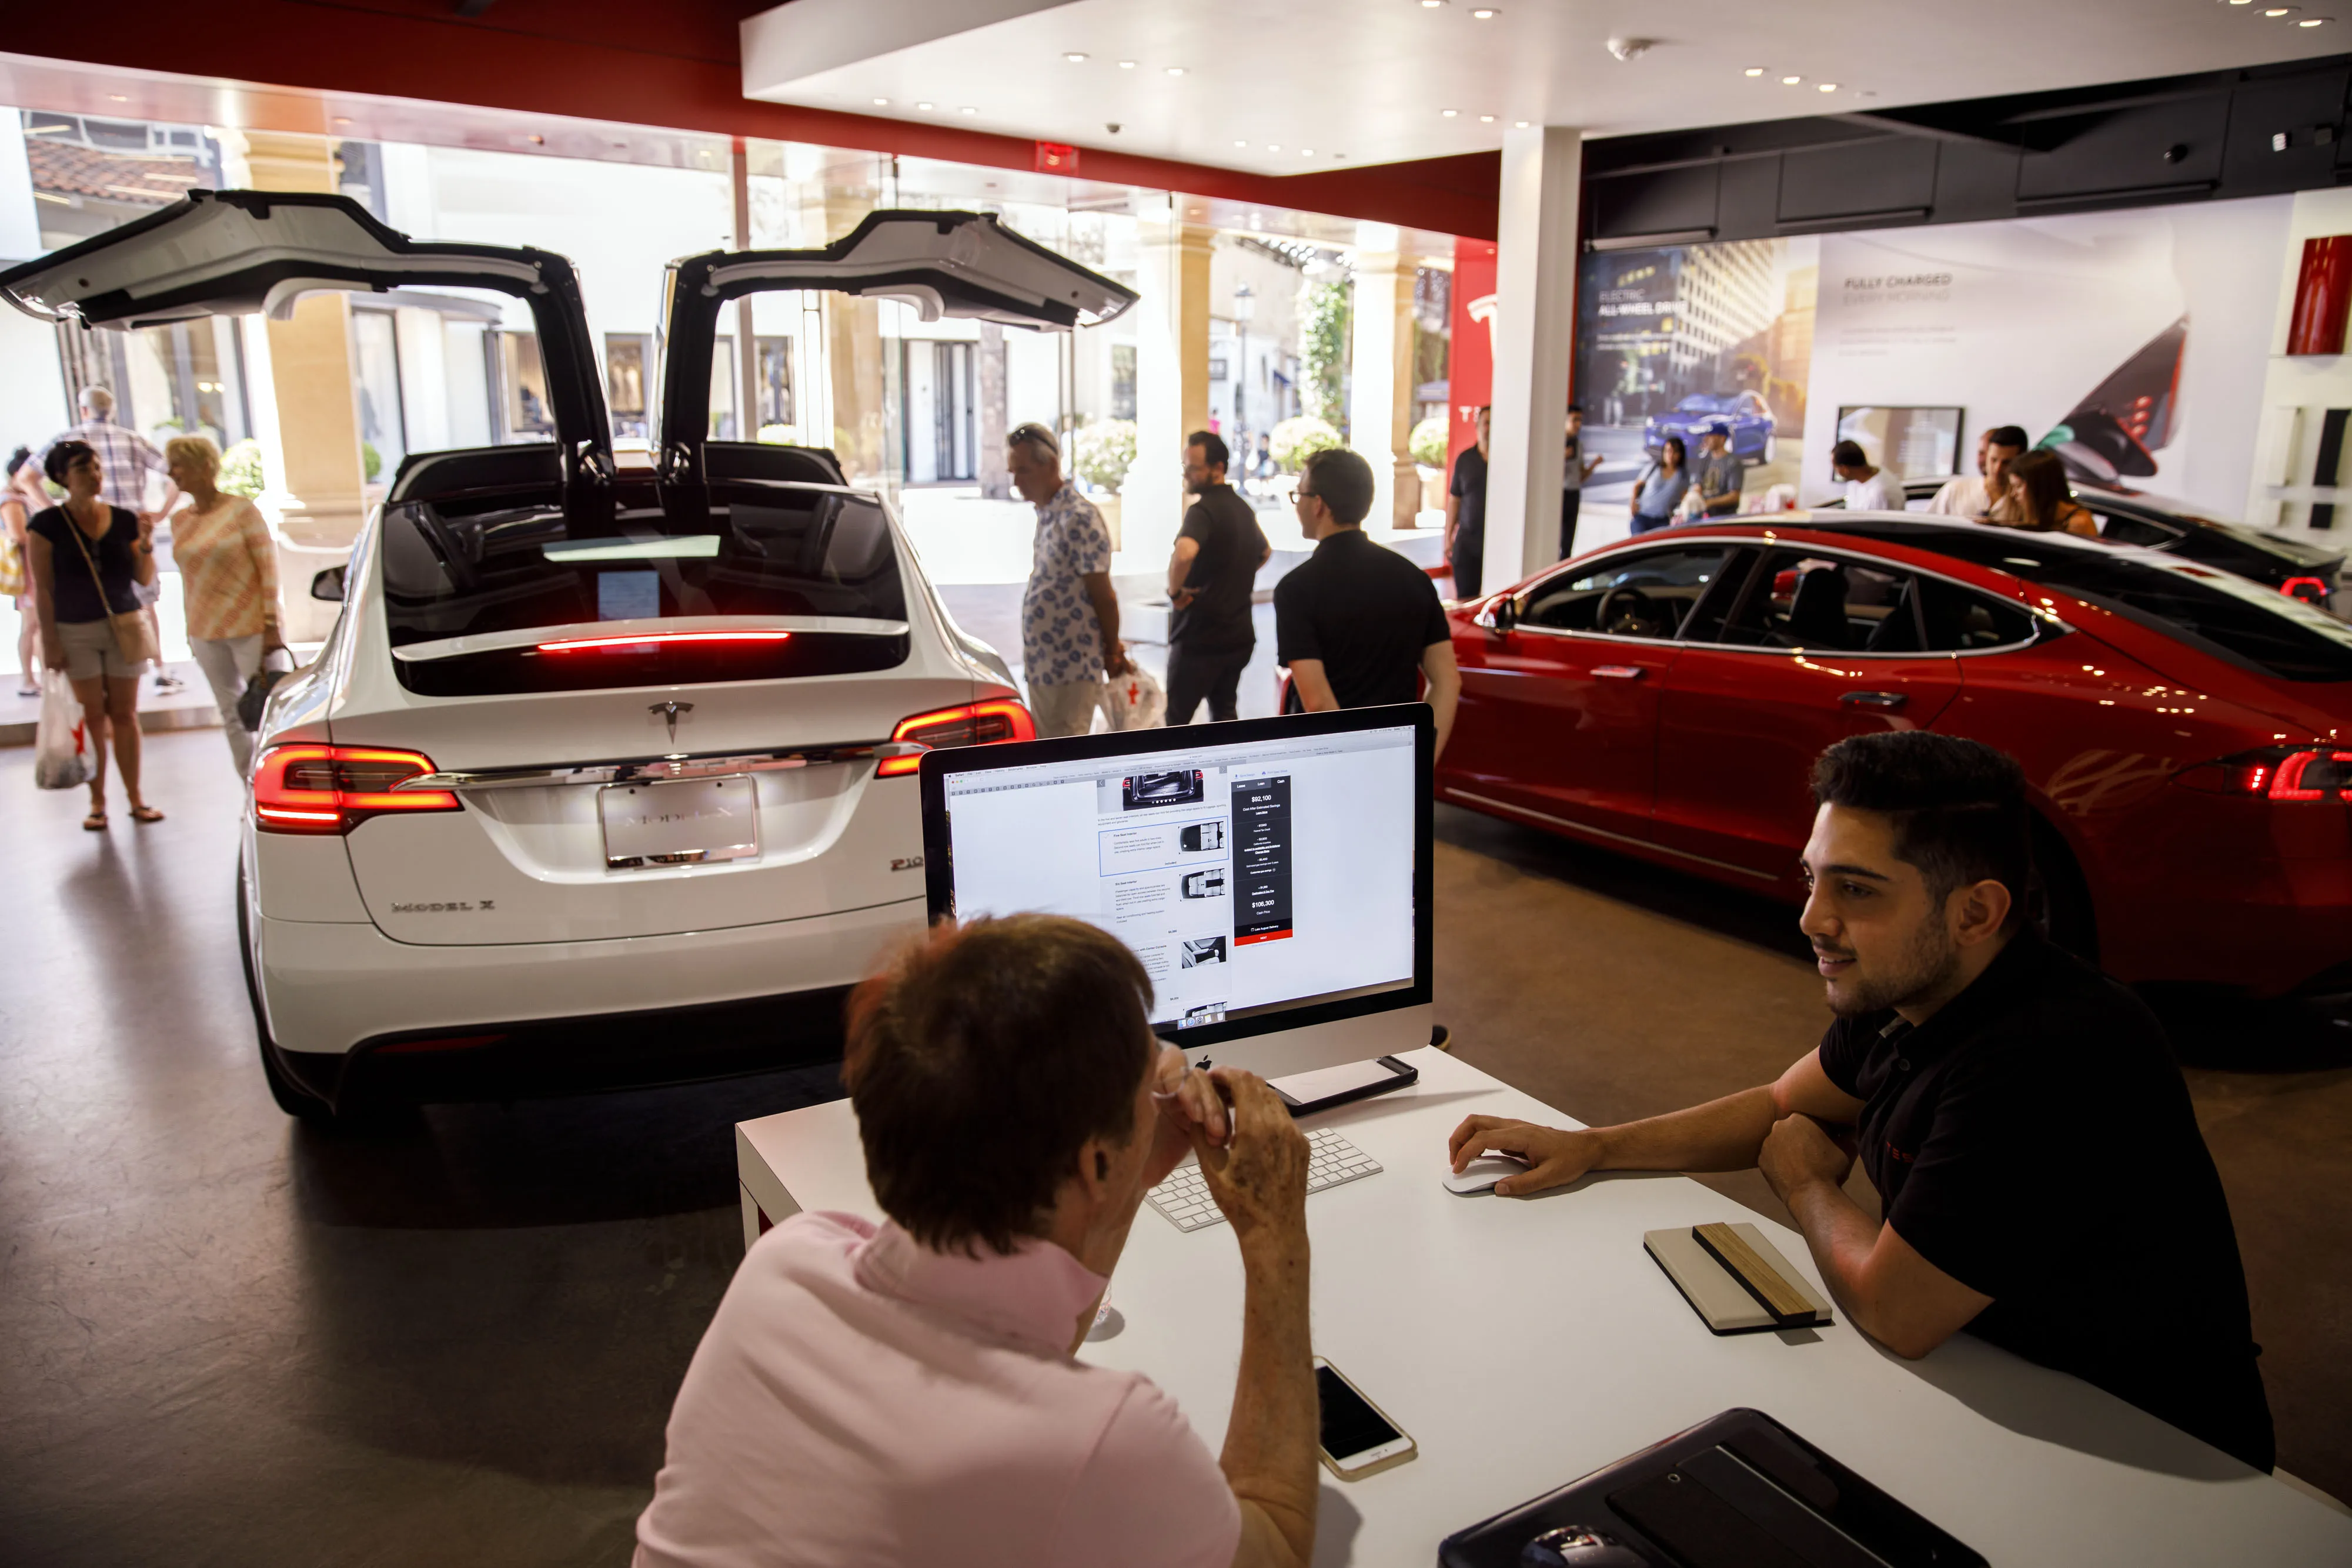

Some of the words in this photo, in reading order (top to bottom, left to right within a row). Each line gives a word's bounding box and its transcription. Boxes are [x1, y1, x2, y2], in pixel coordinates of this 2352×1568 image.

[1844, 277, 1883, 289] FULLY
[1886, 272, 1953, 288] CHARGED
[890, 856, 924, 872] P10
[391, 902, 473, 913] MODEL
[479, 900, 496, 910] X
[1252, 900, 1274, 908] $106,300
[1886, 1141, 1915, 1164] TES
